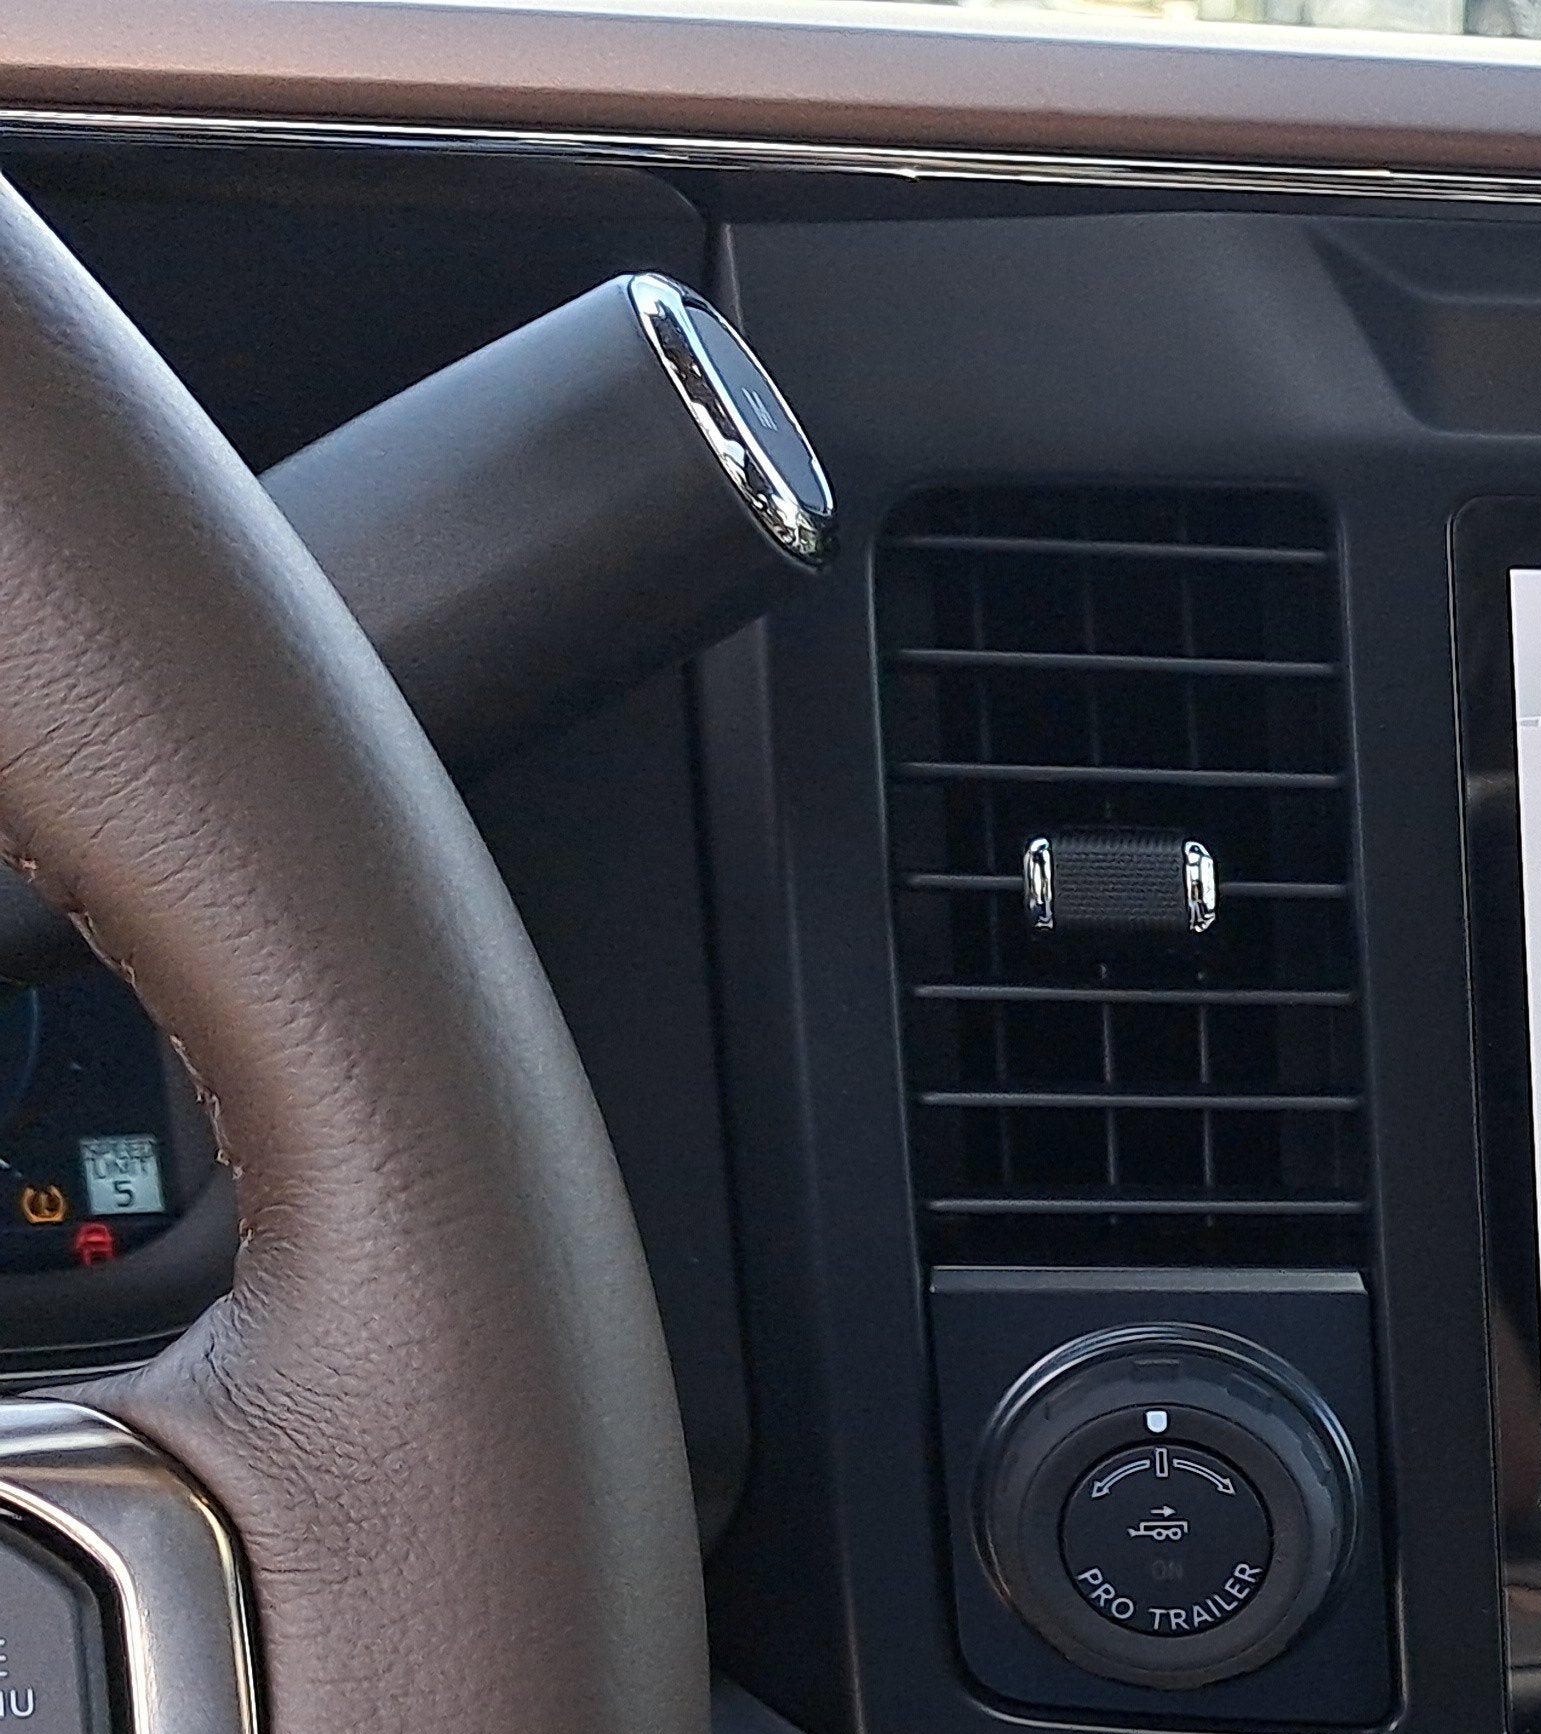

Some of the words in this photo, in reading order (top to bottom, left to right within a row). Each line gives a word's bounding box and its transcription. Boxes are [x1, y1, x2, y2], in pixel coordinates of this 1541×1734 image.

[112, 1180, 134, 1208] 5
[1077, 1567, 1135, 1620] PRO
[1148, 1562, 1265, 1631] TRAILER
